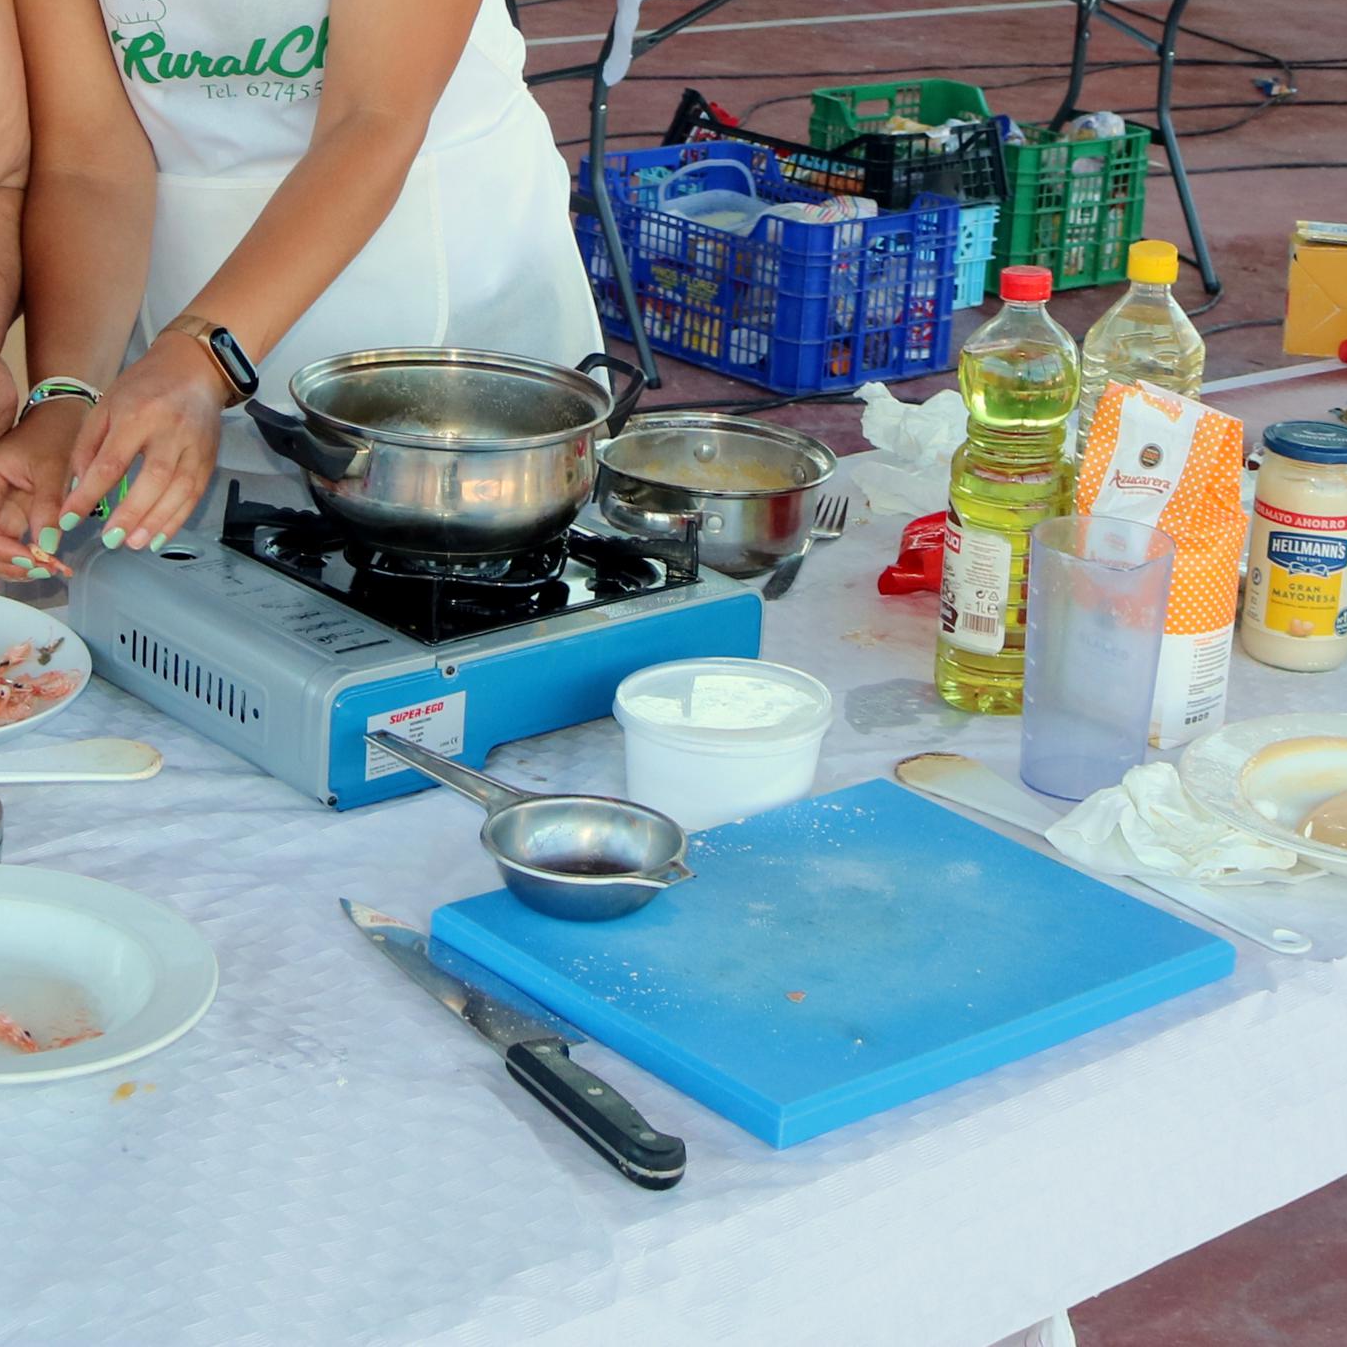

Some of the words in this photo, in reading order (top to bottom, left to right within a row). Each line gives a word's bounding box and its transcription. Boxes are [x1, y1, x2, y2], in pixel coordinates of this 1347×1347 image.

[200, 83, 237, 100] Tel.
[1294, 517, 1346, 529] AHORRO
[1272, 588, 1337, 603] MAYONESA
[1288, 583, 1321, 593] GRAN
[389, 701, 445, 725] SUPER-EGO
